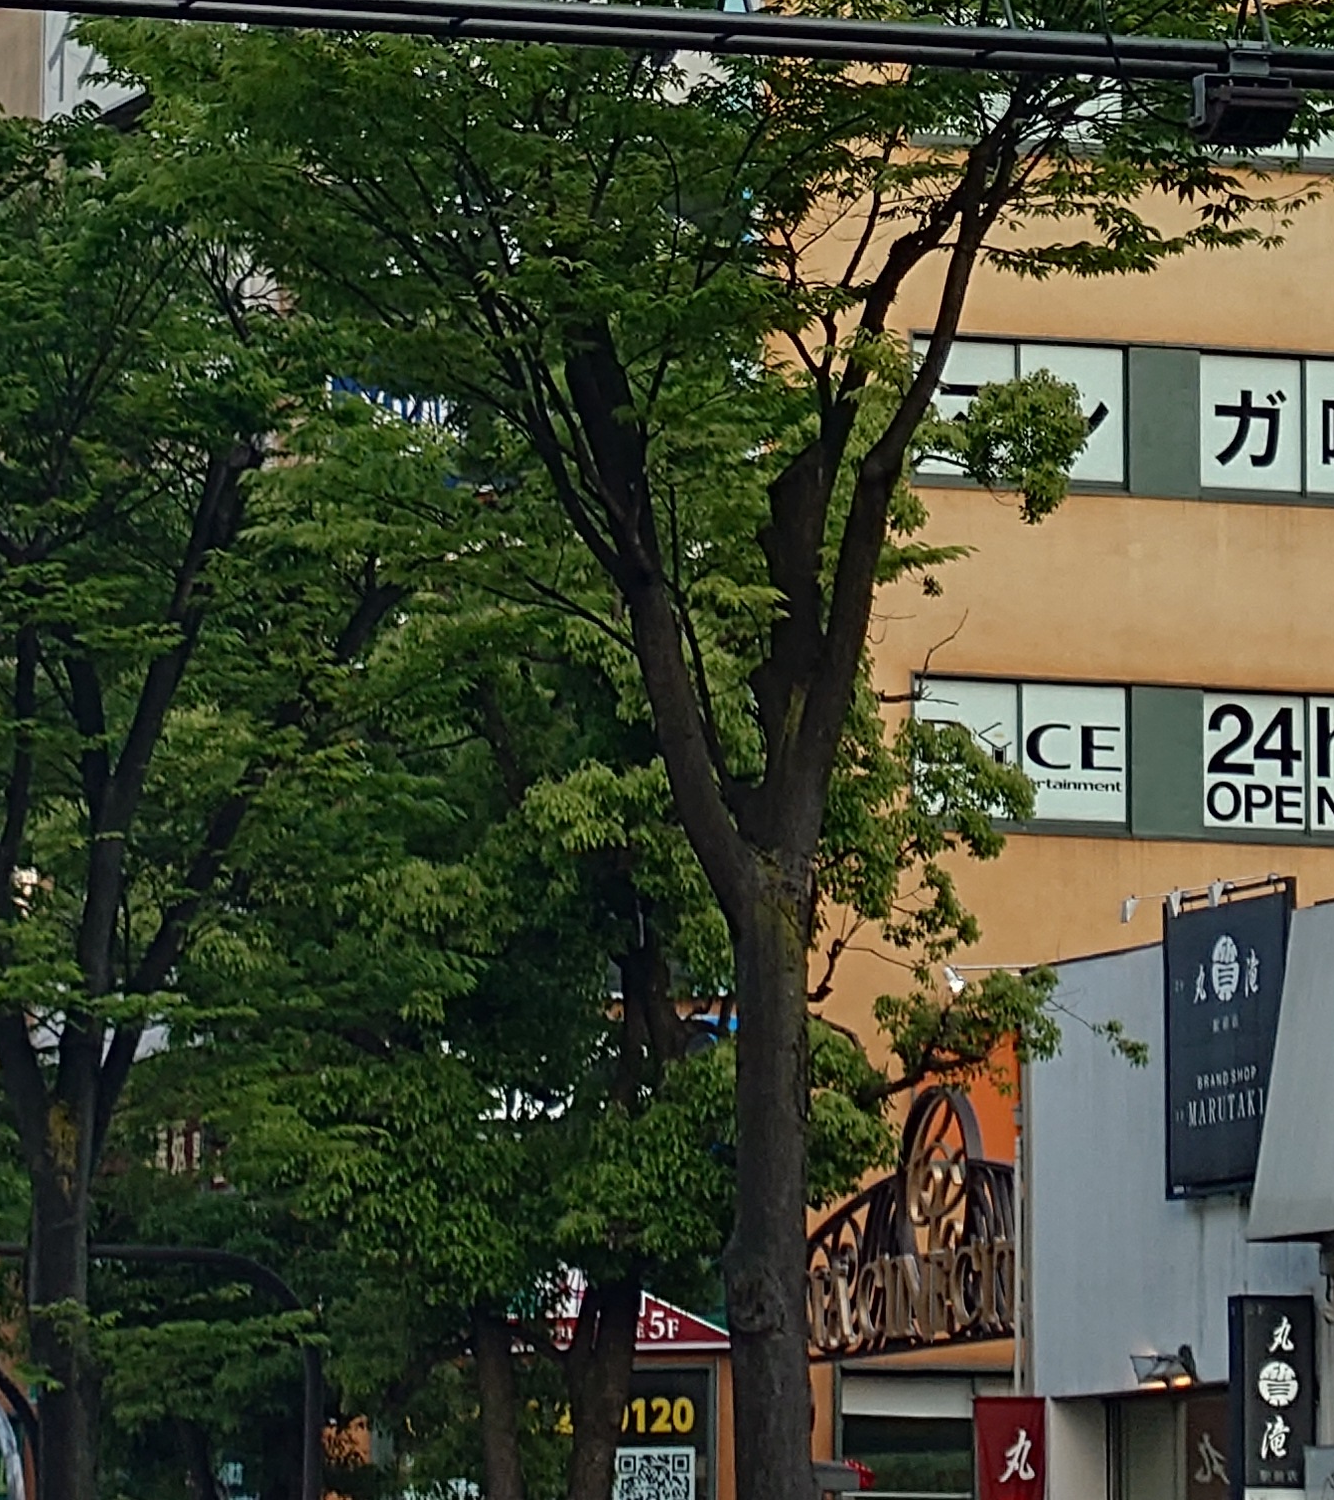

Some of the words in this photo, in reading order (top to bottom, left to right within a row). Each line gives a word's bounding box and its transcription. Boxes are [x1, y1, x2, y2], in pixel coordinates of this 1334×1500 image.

[1196, 1070, 1229, 1091] BRAND
[1230, 1064, 1258, 1085] SHOP
[1187, 1087, 1264, 1128] MARUTAKI
[621, 1396, 696, 1435] 120
[998, 1428, 1036, 1484] 丸
